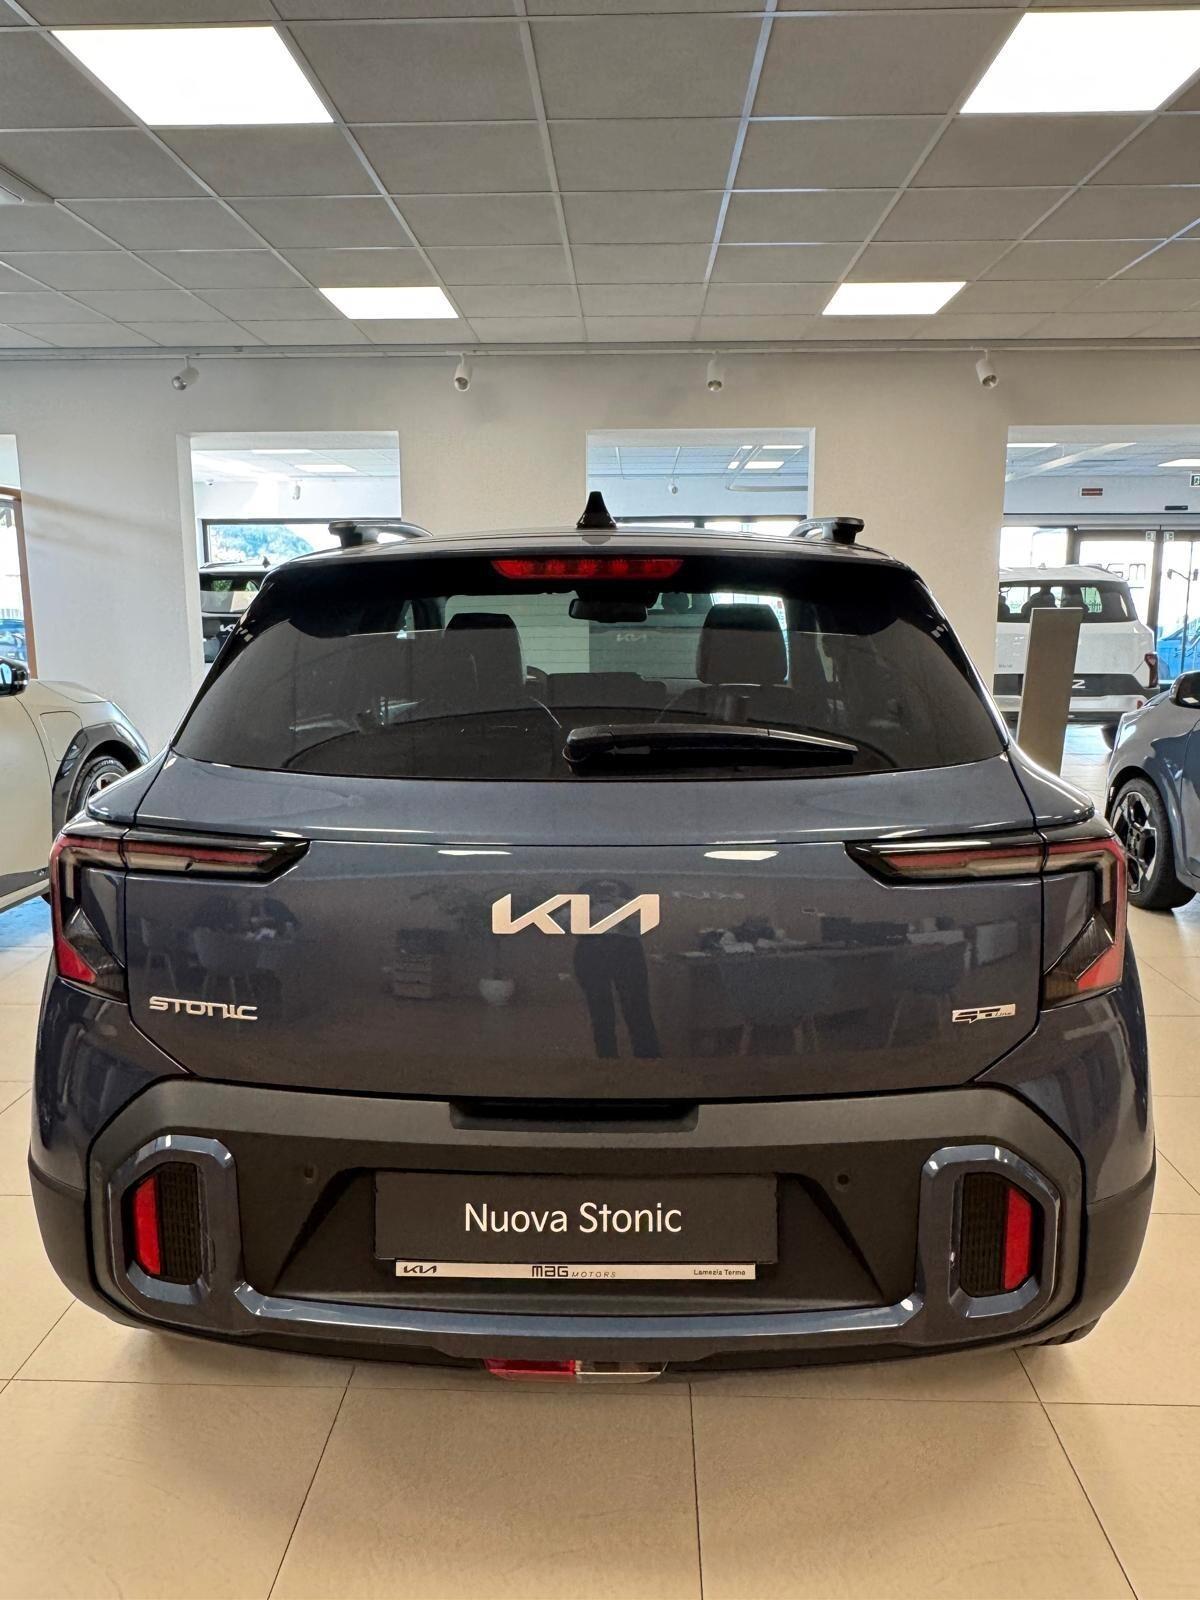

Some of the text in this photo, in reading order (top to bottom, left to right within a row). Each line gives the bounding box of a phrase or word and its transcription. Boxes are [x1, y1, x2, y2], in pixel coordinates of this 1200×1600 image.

[492, 893, 660, 935] KIA
[149, 996, 258, 1020] STONIC
[465, 1202, 682, 1233] Nuova Stonic
[403, 1264, 437, 1274] KIA
